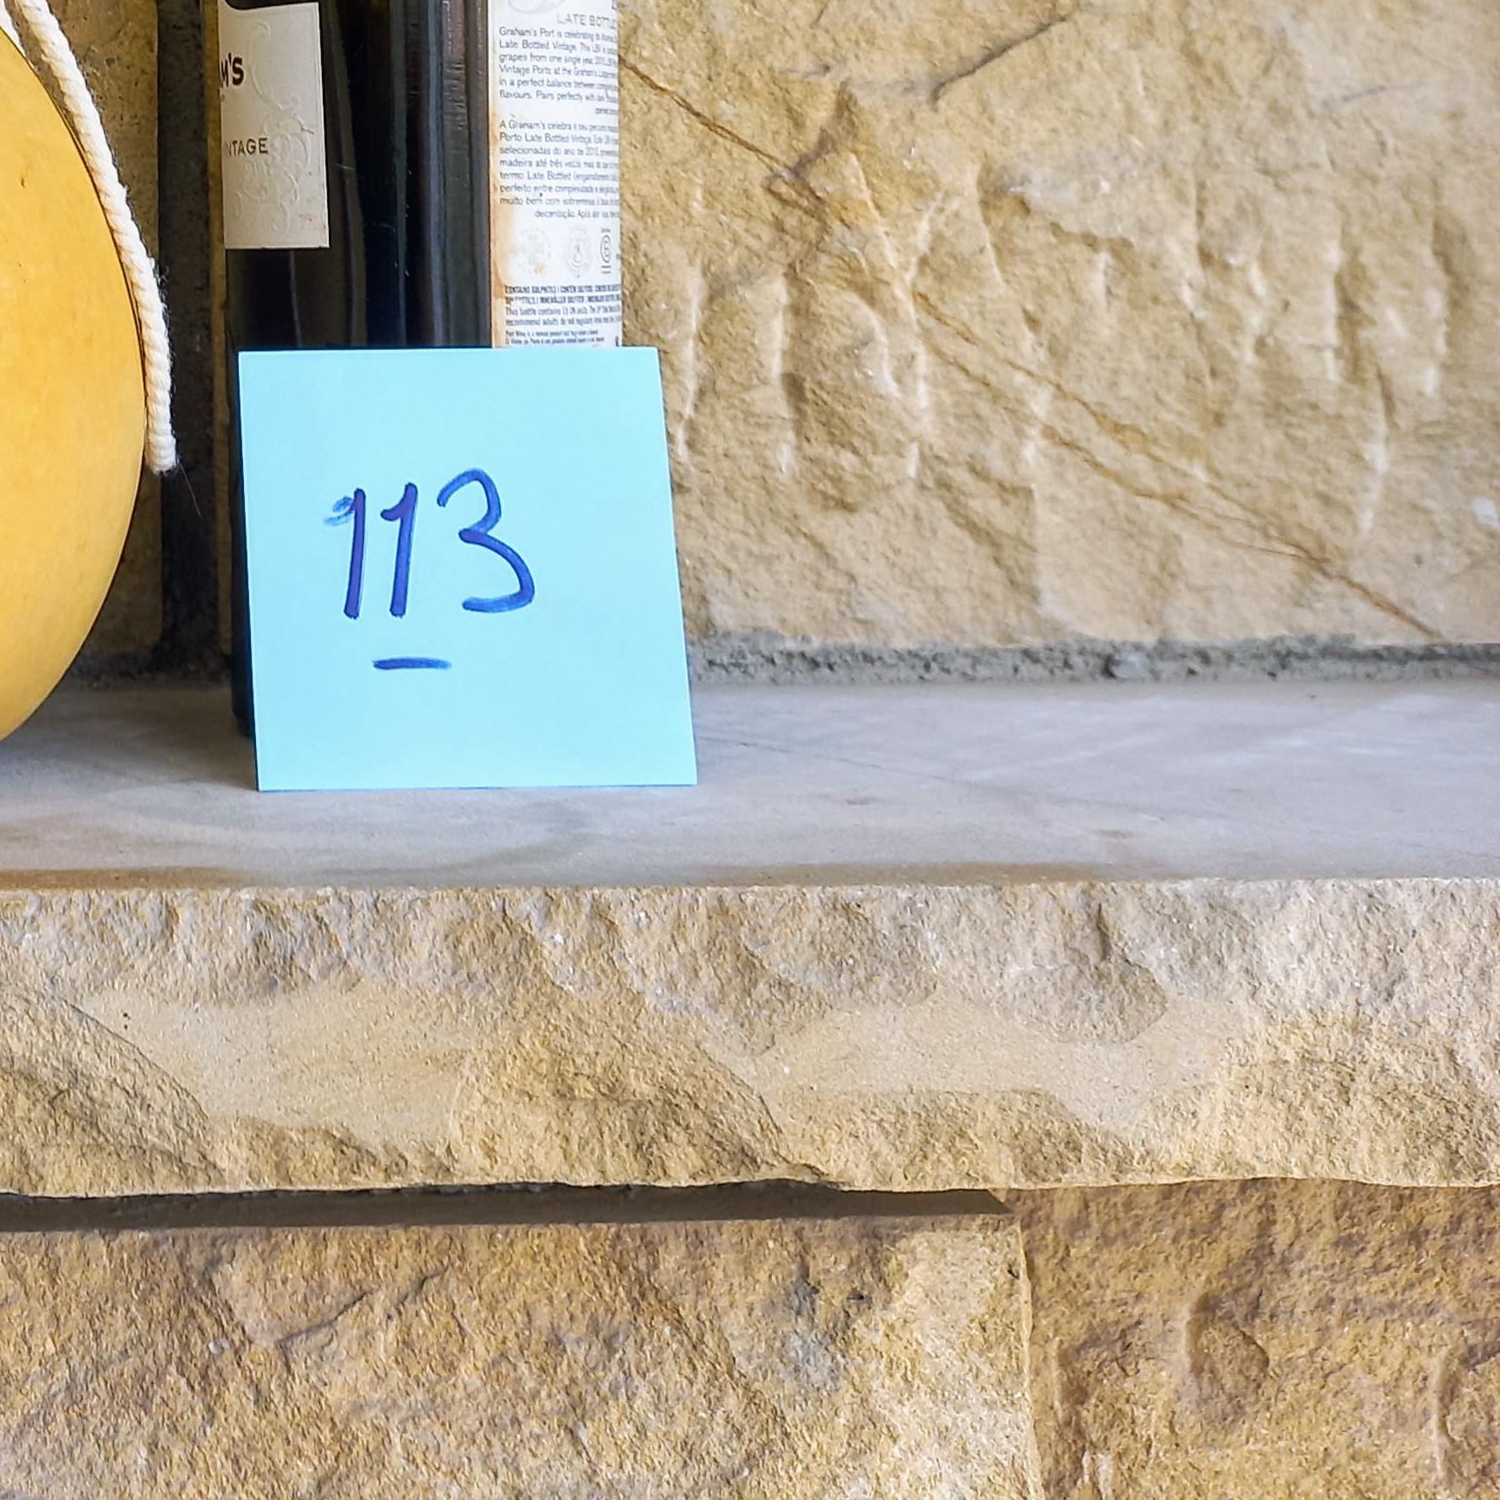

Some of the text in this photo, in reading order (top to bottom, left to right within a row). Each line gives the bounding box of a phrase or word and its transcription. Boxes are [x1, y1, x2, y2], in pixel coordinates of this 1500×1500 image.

[557, 13, 586, 26] LATE
[499, 26, 537, 37] Graham's
[540, 27, 555, 37] Port
[499, 40, 518, 49] Late
[522, 40, 549, 49] Bottled
[499, 53, 527, 64] grapes
[530, 53, 547, 62] from
[499, 64, 530, 76] Vintage
[533, 65, 551, 75] Ports
[517, 78, 545, 88] perfect
[499, 120, 506, 129] A
[508, 119, 546, 130] Graham's
[499, 132, 522, 142] Porto
[524, 132, 542, 142] Late
[499, 146, 550, 155] selecionadas
[499, 158, 533, 167] madeira
[499, 171, 524, 180] termo
[527, 171, 544, 180] Late
[499, 183, 531, 193] perfeito
[533, 184, 553, 192] entre
[499, 197, 523, 205] muito
[526, 197, 543, 205] bem
[545, 198, 561, 206] com
[324, 468, 534, 619] 113
